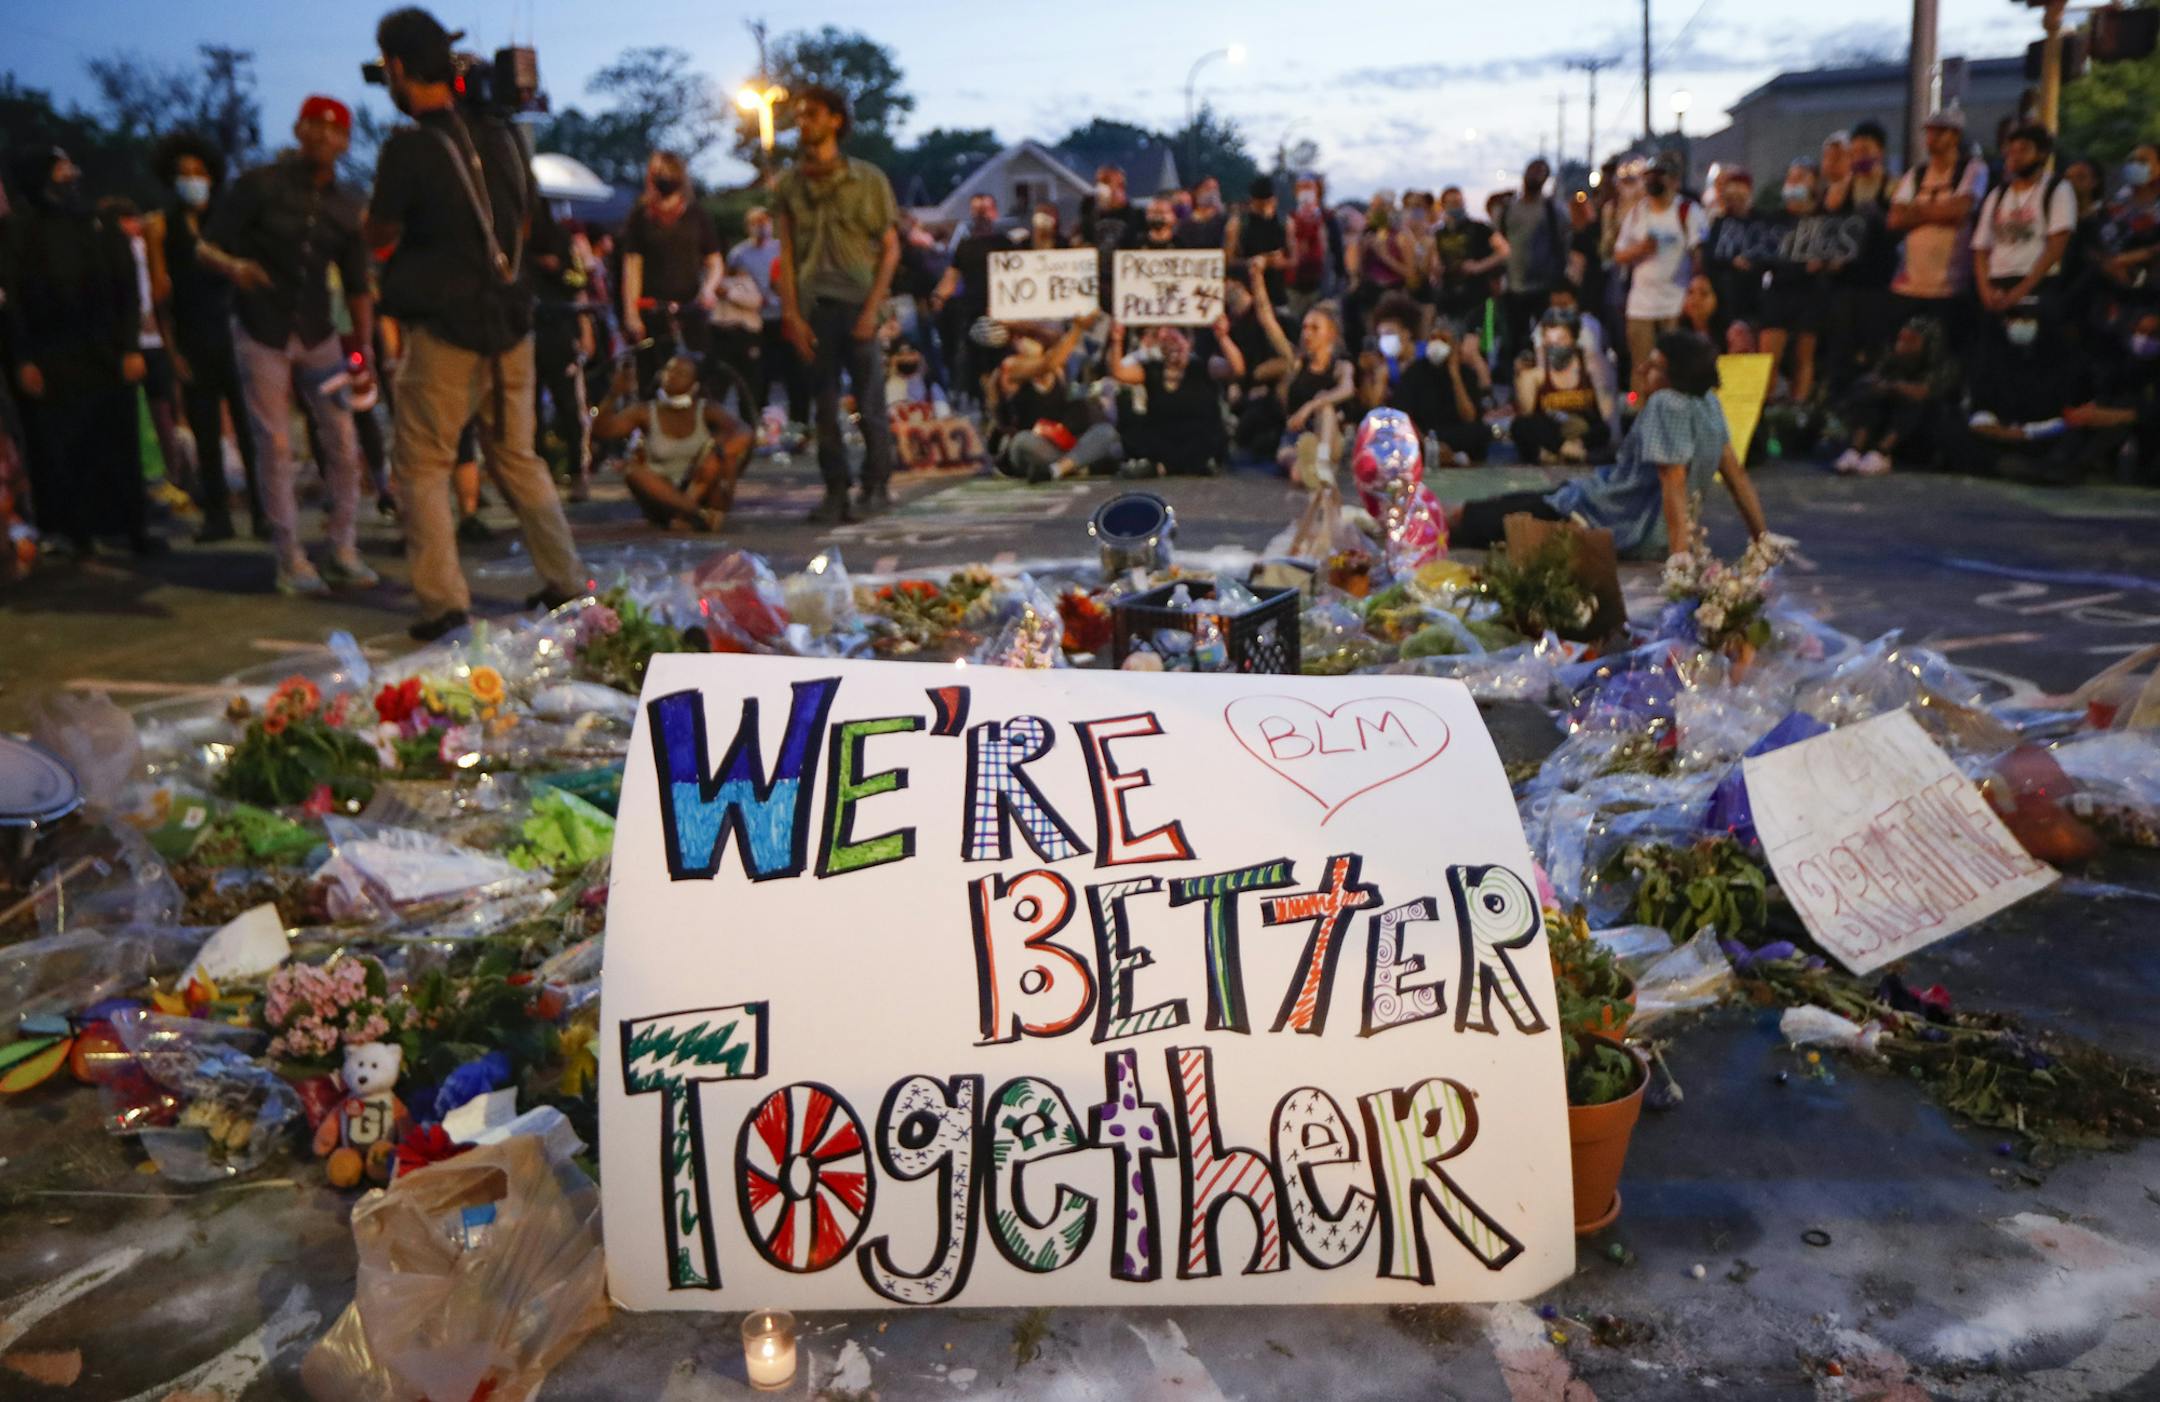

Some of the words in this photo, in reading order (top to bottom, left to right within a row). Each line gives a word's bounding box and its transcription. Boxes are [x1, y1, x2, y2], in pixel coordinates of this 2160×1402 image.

[995, 252, 1024, 271] NO
[998, 277, 1038, 303] NO
[1259, 710, 1418, 760] BLM
[647, 675, 1196, 880] WE'RE
[1780, 772, 2046, 958] BREATHE
